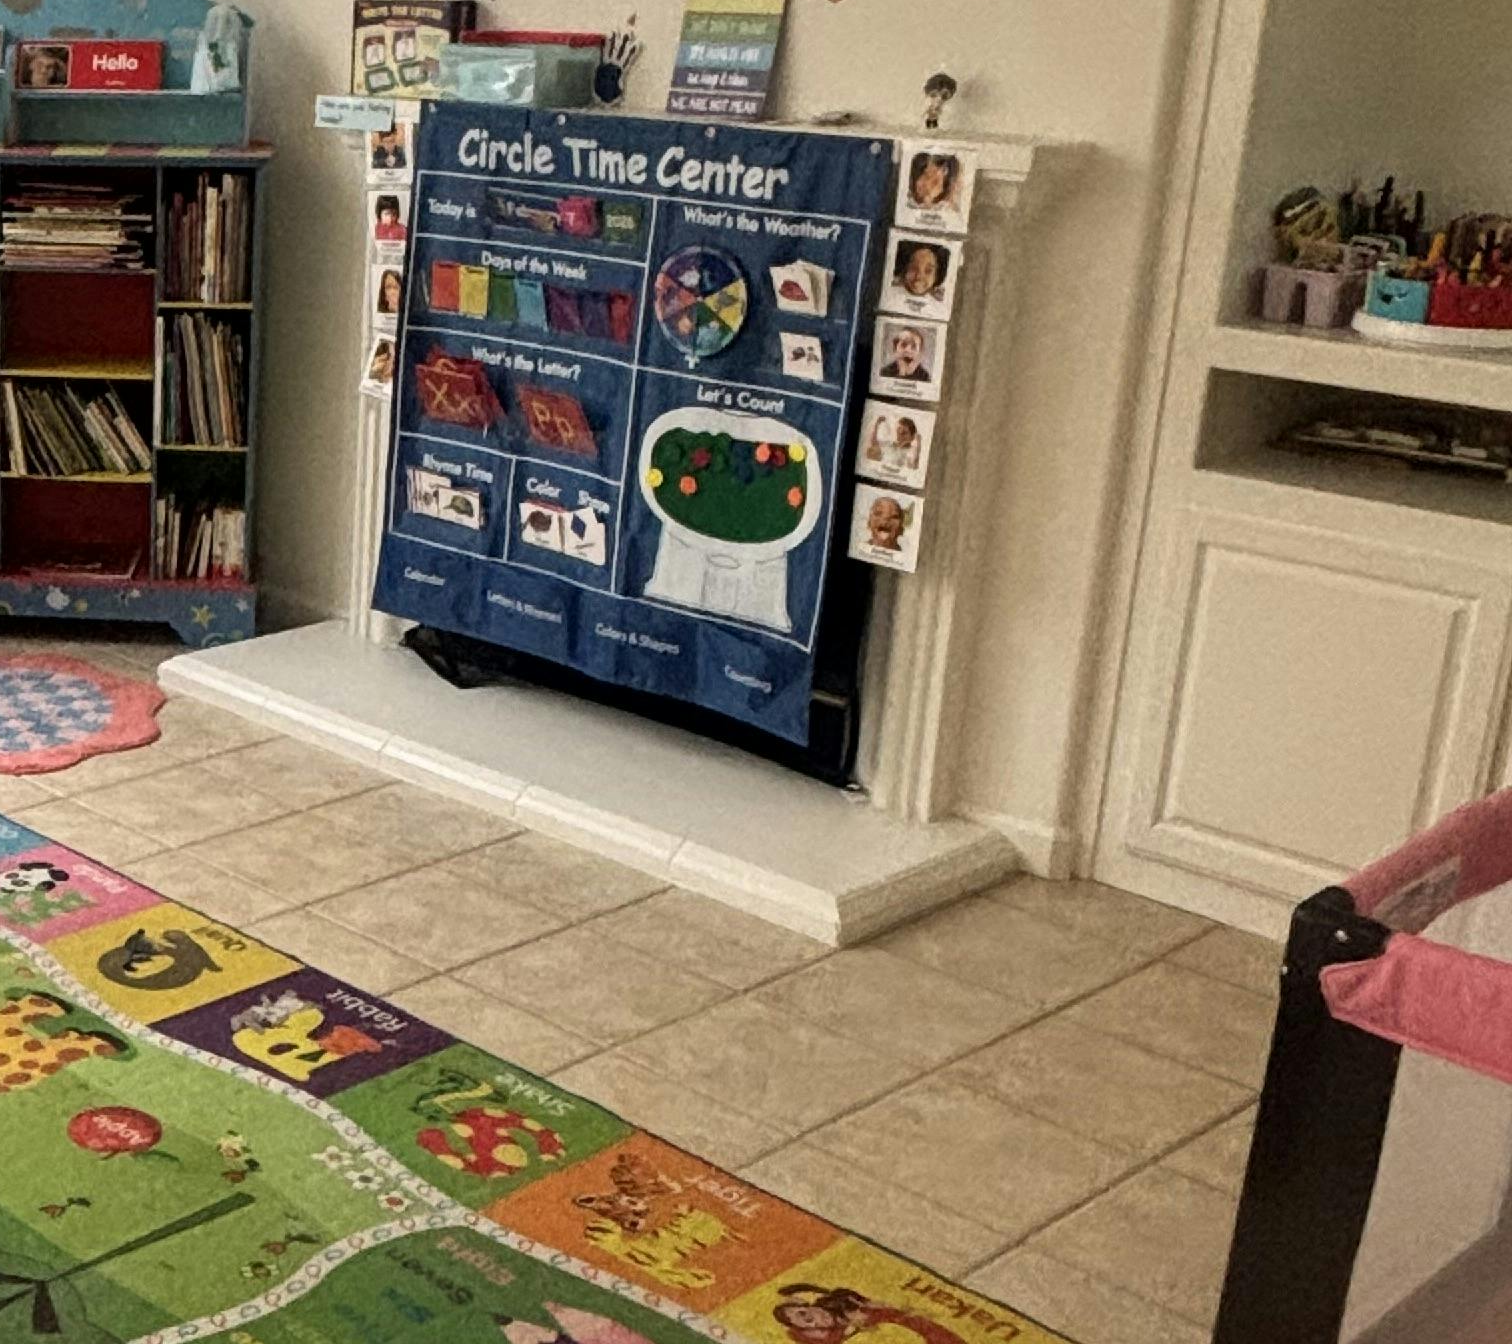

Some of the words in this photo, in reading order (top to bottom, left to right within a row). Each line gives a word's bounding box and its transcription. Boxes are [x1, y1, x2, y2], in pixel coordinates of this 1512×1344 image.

[92, 53, 138, 72] Hello
[458, 128, 555, 174] Circle
[562, 136, 647, 184] Time
[656, 146, 789, 200] Center
[428, 198, 463, 220] Today
[465, 204, 477, 219] is
[684, 206, 733, 230] What's
[736, 212, 759, 233] the
[764, 216, 842, 241] Weather?
[481, 250, 512, 271] Days
[514, 254, 528, 269] of
[529, 257, 549, 275] the
[552, 261, 588, 280] Week
[471, 346, 513, 369] What's
[514, 355, 534, 373] the
[537, 360, 583, 382] Letter?
[696, 383, 732, 406] Let's
[736, 391, 786, 414] Count
[465, 461, 494, 484] Time
[526, 476, 561, 498] Color
[324, 988, 408, 1031] Rabbit
[494, 1072, 576, 1116] Snake
[90, 1114, 150, 1146] Apple
[680, 1173, 761, 1220] Tiger
[900, 1275, 1023, 1343] Uakari
